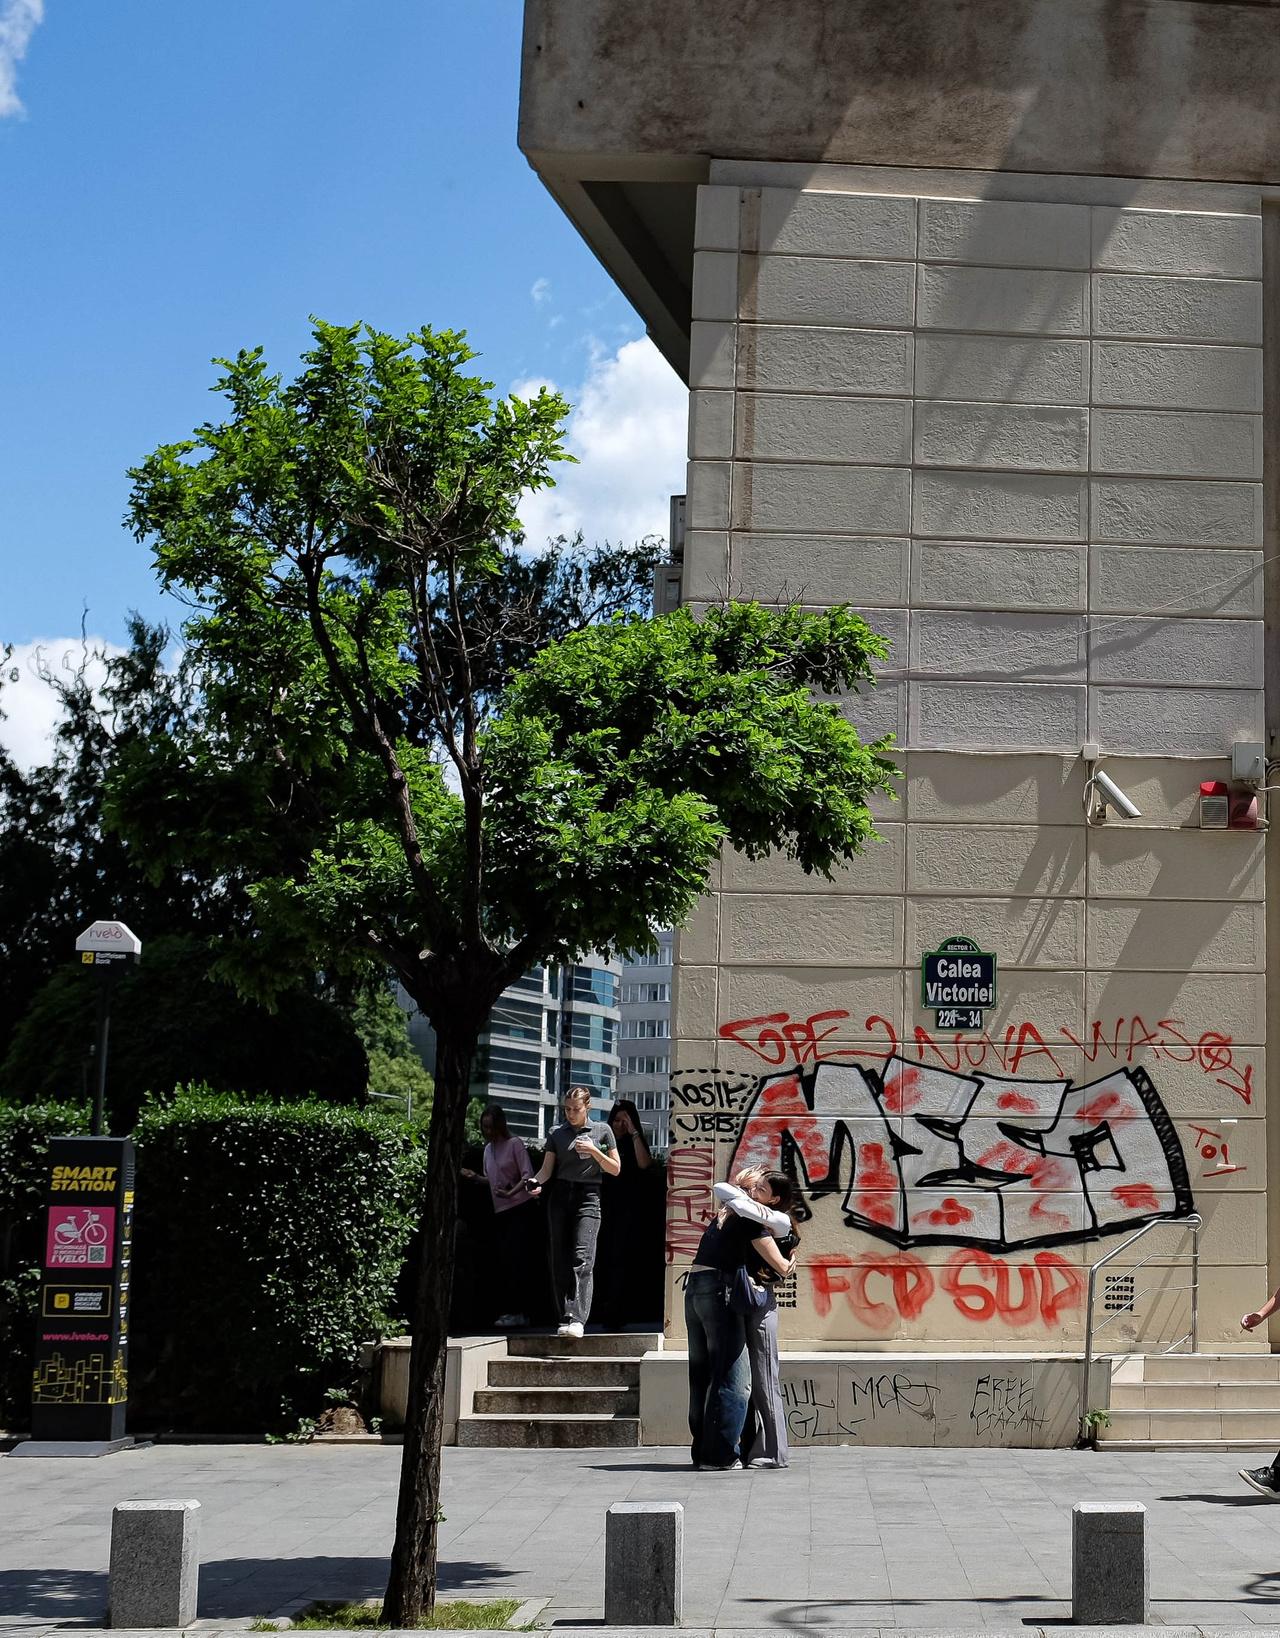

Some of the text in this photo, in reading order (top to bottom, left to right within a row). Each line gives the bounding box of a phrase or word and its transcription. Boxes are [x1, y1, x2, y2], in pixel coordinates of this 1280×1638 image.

[937, 958, 981, 978] Calea
[926, 982, 993, 1002] Victoriei
[969, 1010, 981, 1027] 34
[51, 1166, 118, 1180] SMART
[50, 1180, 116, 1191] STATION
